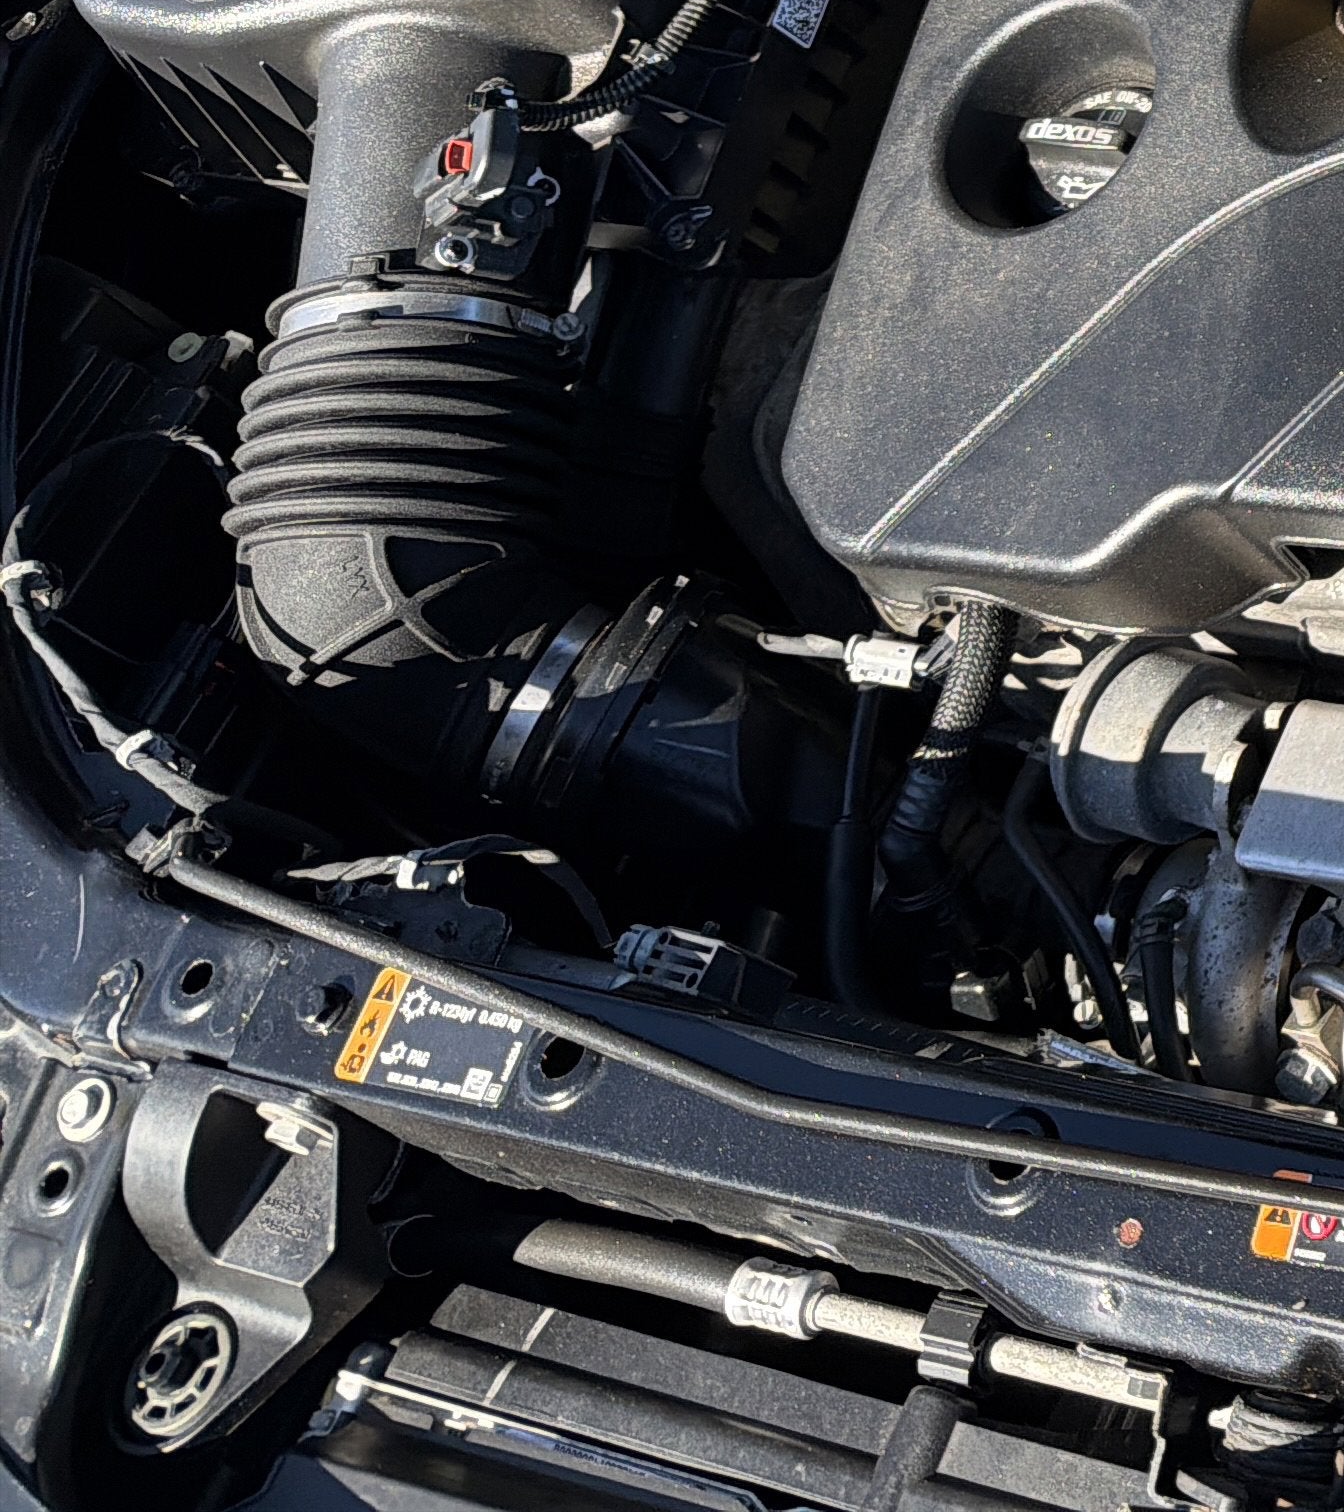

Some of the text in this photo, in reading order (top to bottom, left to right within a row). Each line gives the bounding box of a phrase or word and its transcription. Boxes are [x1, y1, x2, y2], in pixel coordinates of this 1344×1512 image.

[1083, 91, 1112, 110] SAE
[1027, 118, 1118, 145] dexos
[406, 1048, 432, 1069] PAG
